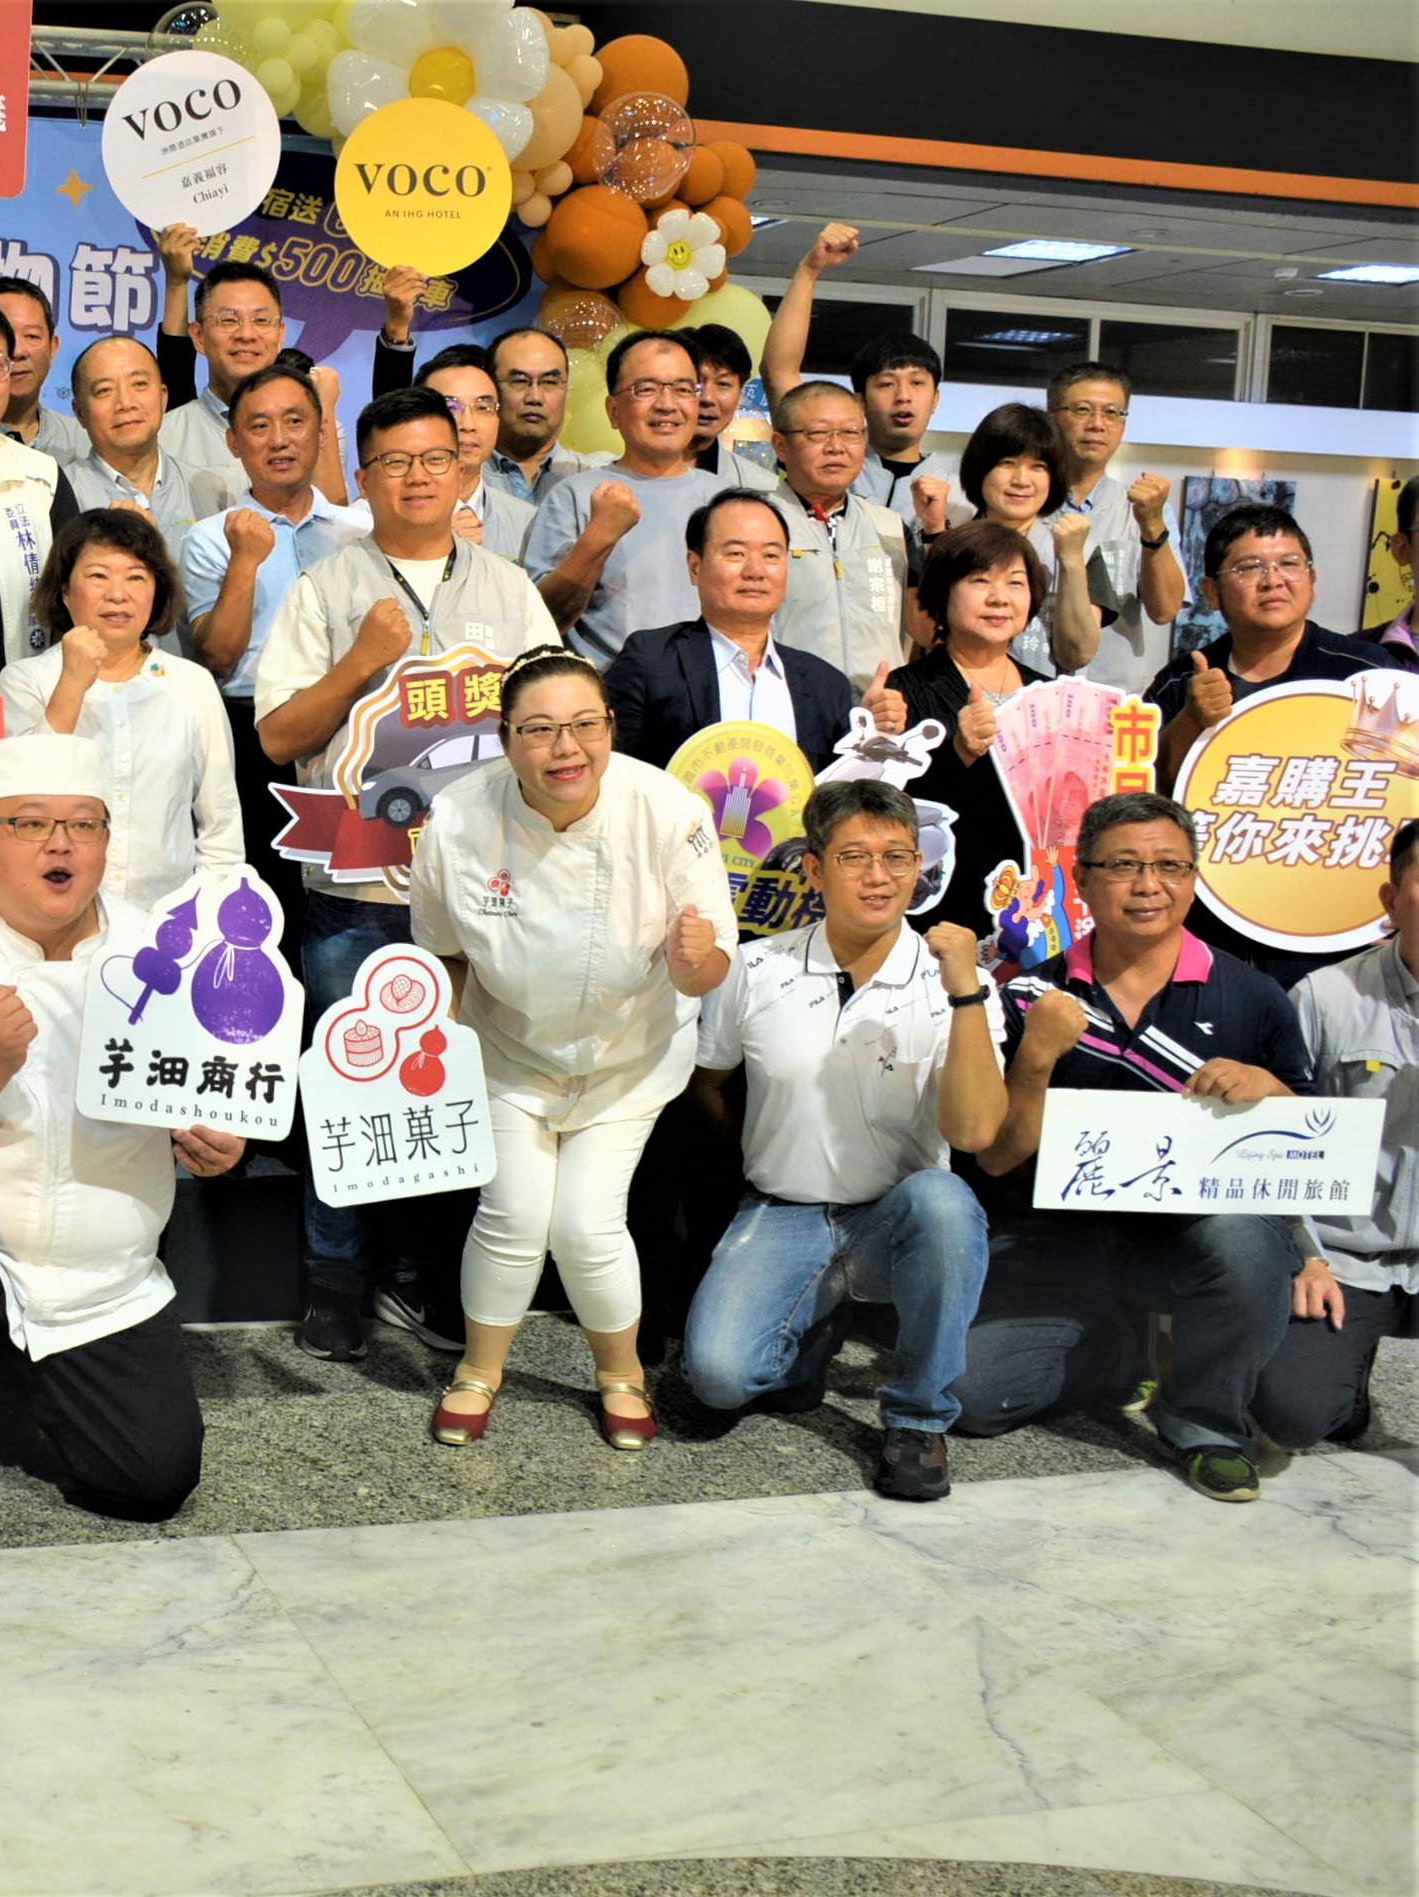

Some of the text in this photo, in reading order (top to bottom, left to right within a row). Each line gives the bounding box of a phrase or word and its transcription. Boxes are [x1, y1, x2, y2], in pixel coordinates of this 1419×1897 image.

[193, 183, 229, 205] Chiayi
[385, 209, 462, 219] AN IHG HOTEL
[193, 232, 458, 310] 消費$500抽車
[406, 671, 502, 721] 頭獎
[1212, 754, 1398, 809] 嘉購王
[100, 1094, 278, 1127] Imodashoukou
[333, 1163, 479, 1193] Imodagashi
[1060, 1130, 1183, 1202] 麗景
